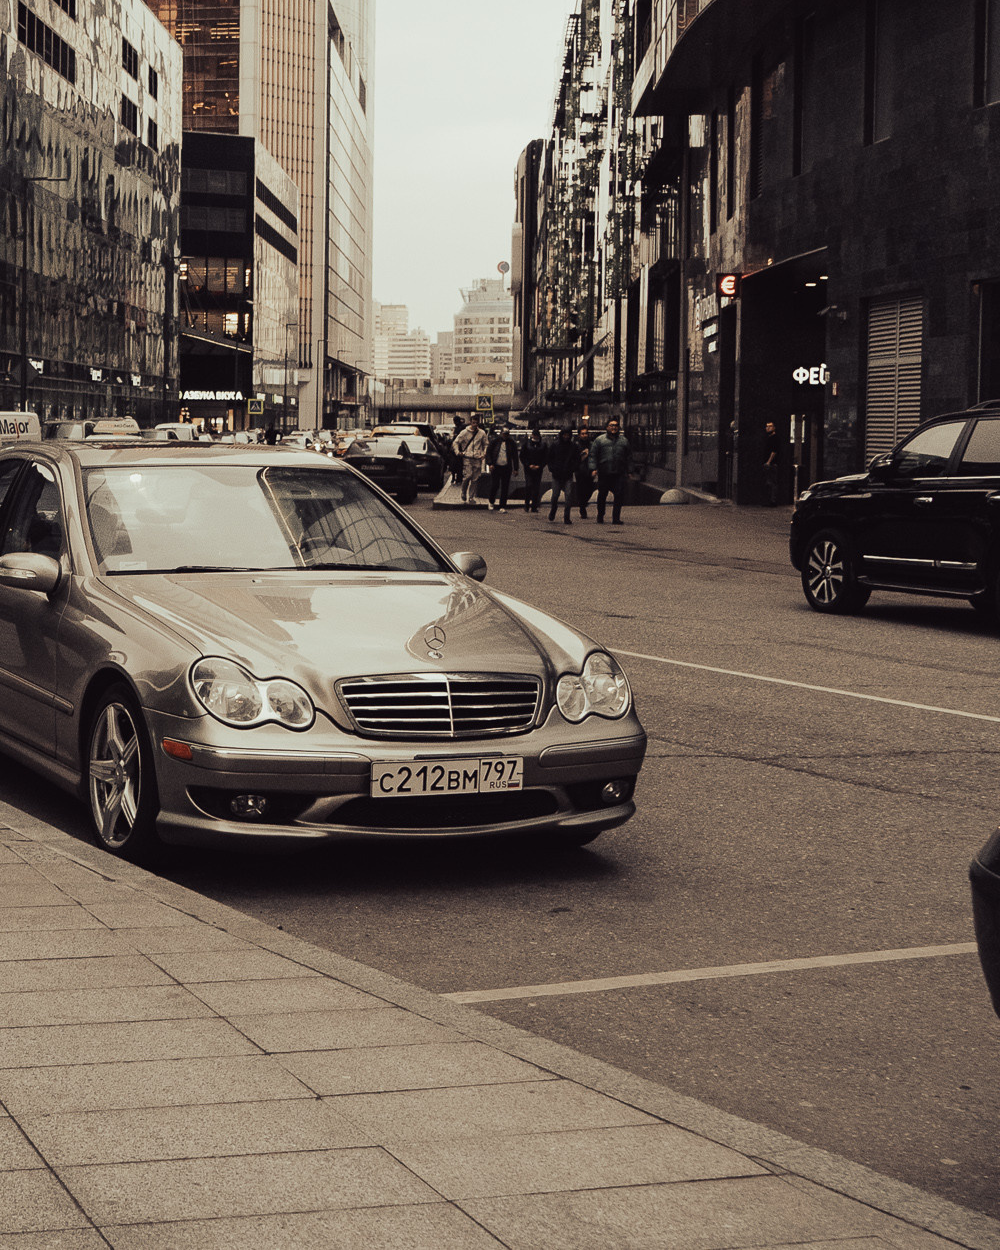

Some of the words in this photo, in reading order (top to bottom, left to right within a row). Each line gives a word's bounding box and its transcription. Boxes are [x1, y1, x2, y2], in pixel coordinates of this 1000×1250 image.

[182, 390, 216, 401] АЗБУКА
[481, 760, 518, 782] 797
[489, 780, 508, 789] RUS
